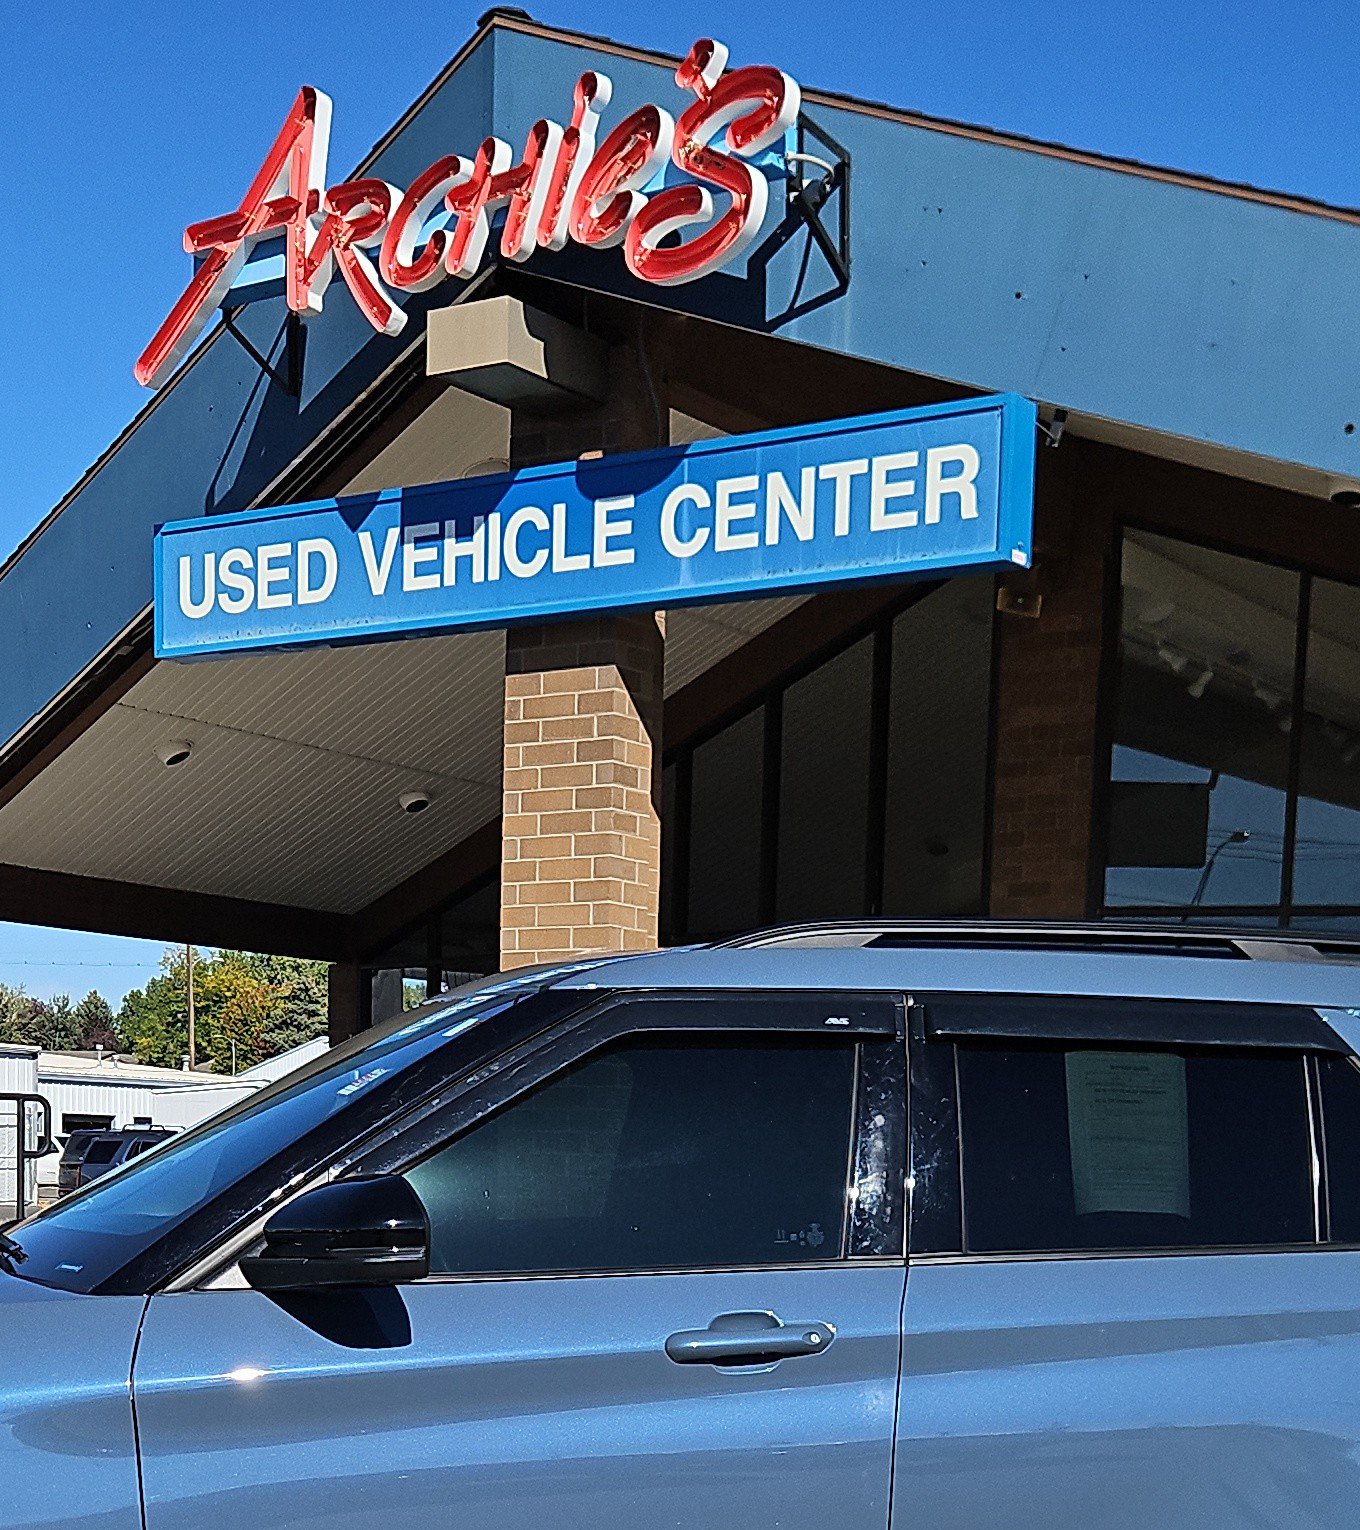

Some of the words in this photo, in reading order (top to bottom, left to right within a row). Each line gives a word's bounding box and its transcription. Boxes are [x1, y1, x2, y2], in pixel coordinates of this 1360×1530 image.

[177, 538, 338, 619] USED
[358, 494, 636, 598] VEHICLE
[660, 444, 981, 553] CENTER
